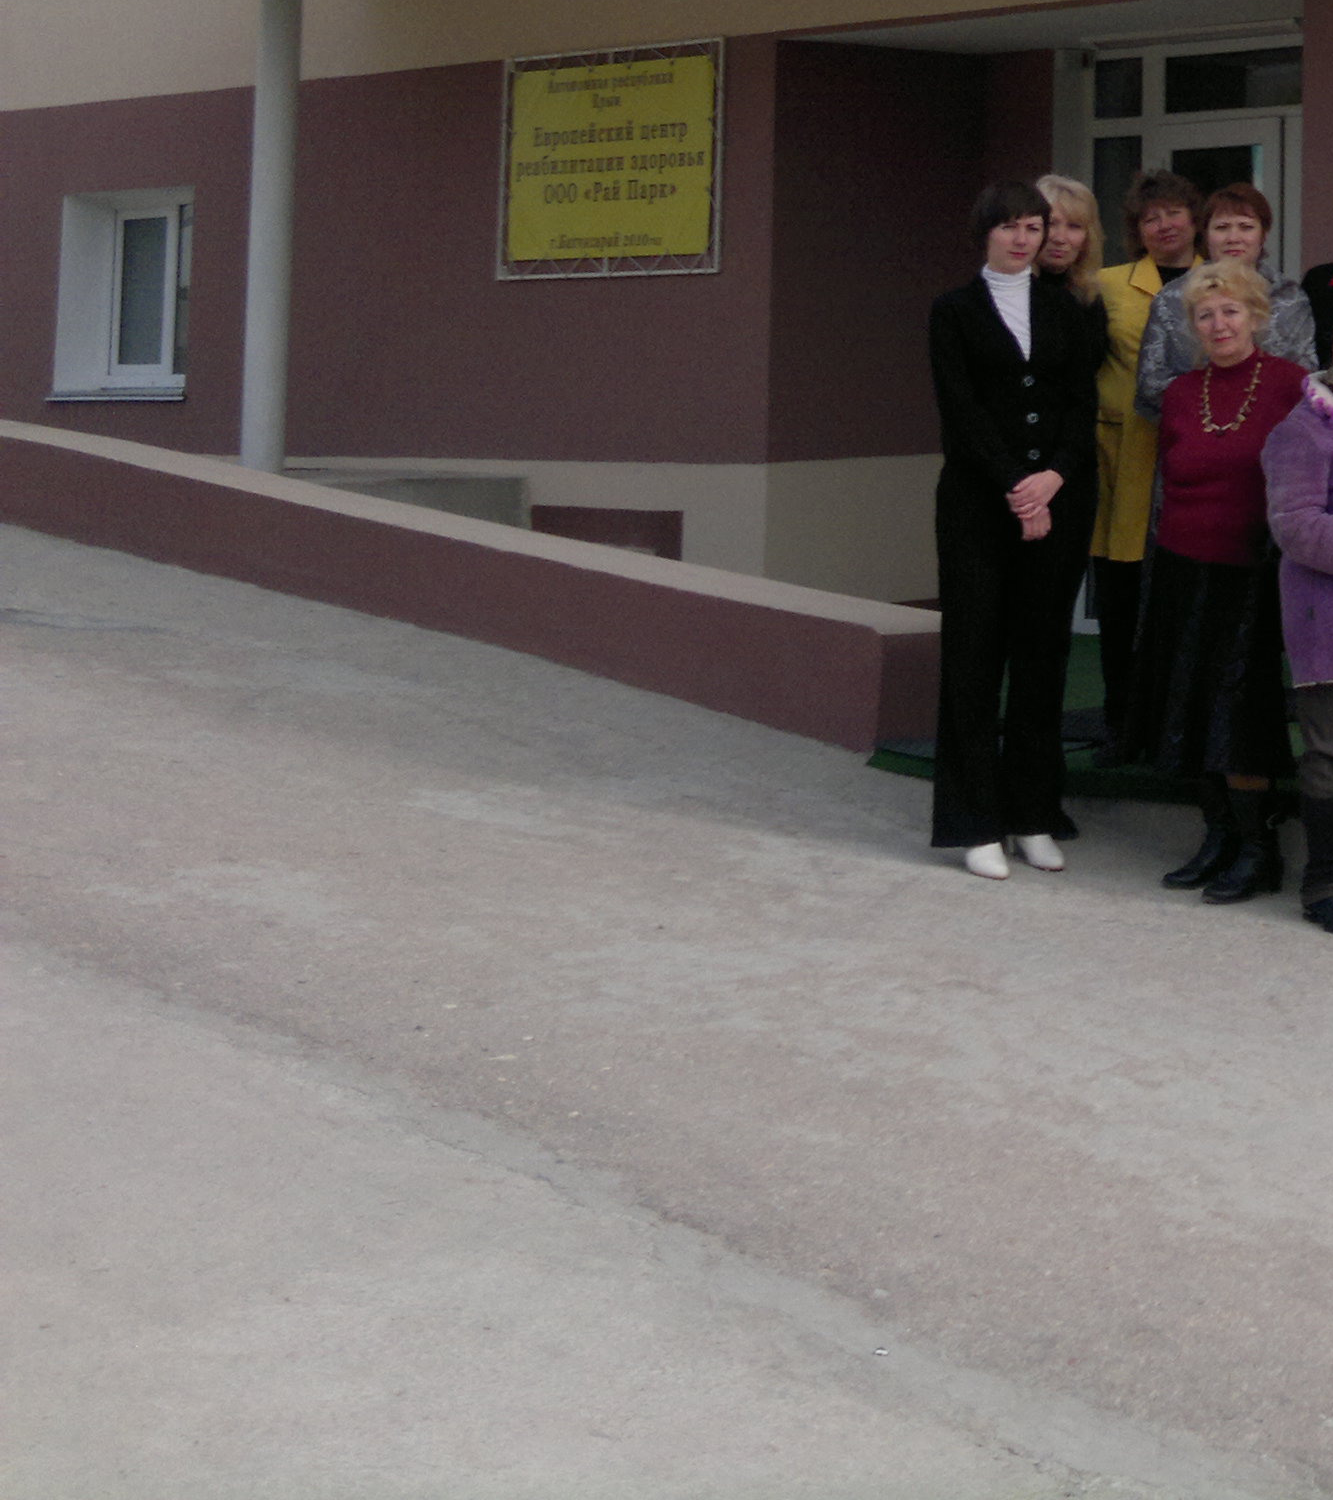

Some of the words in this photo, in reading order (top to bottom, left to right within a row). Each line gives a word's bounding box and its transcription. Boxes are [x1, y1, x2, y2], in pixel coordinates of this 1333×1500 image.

[640, 121, 689, 143] центр
[630, 150, 706, 174] здоровья
[543, 181, 578, 206] ООО
